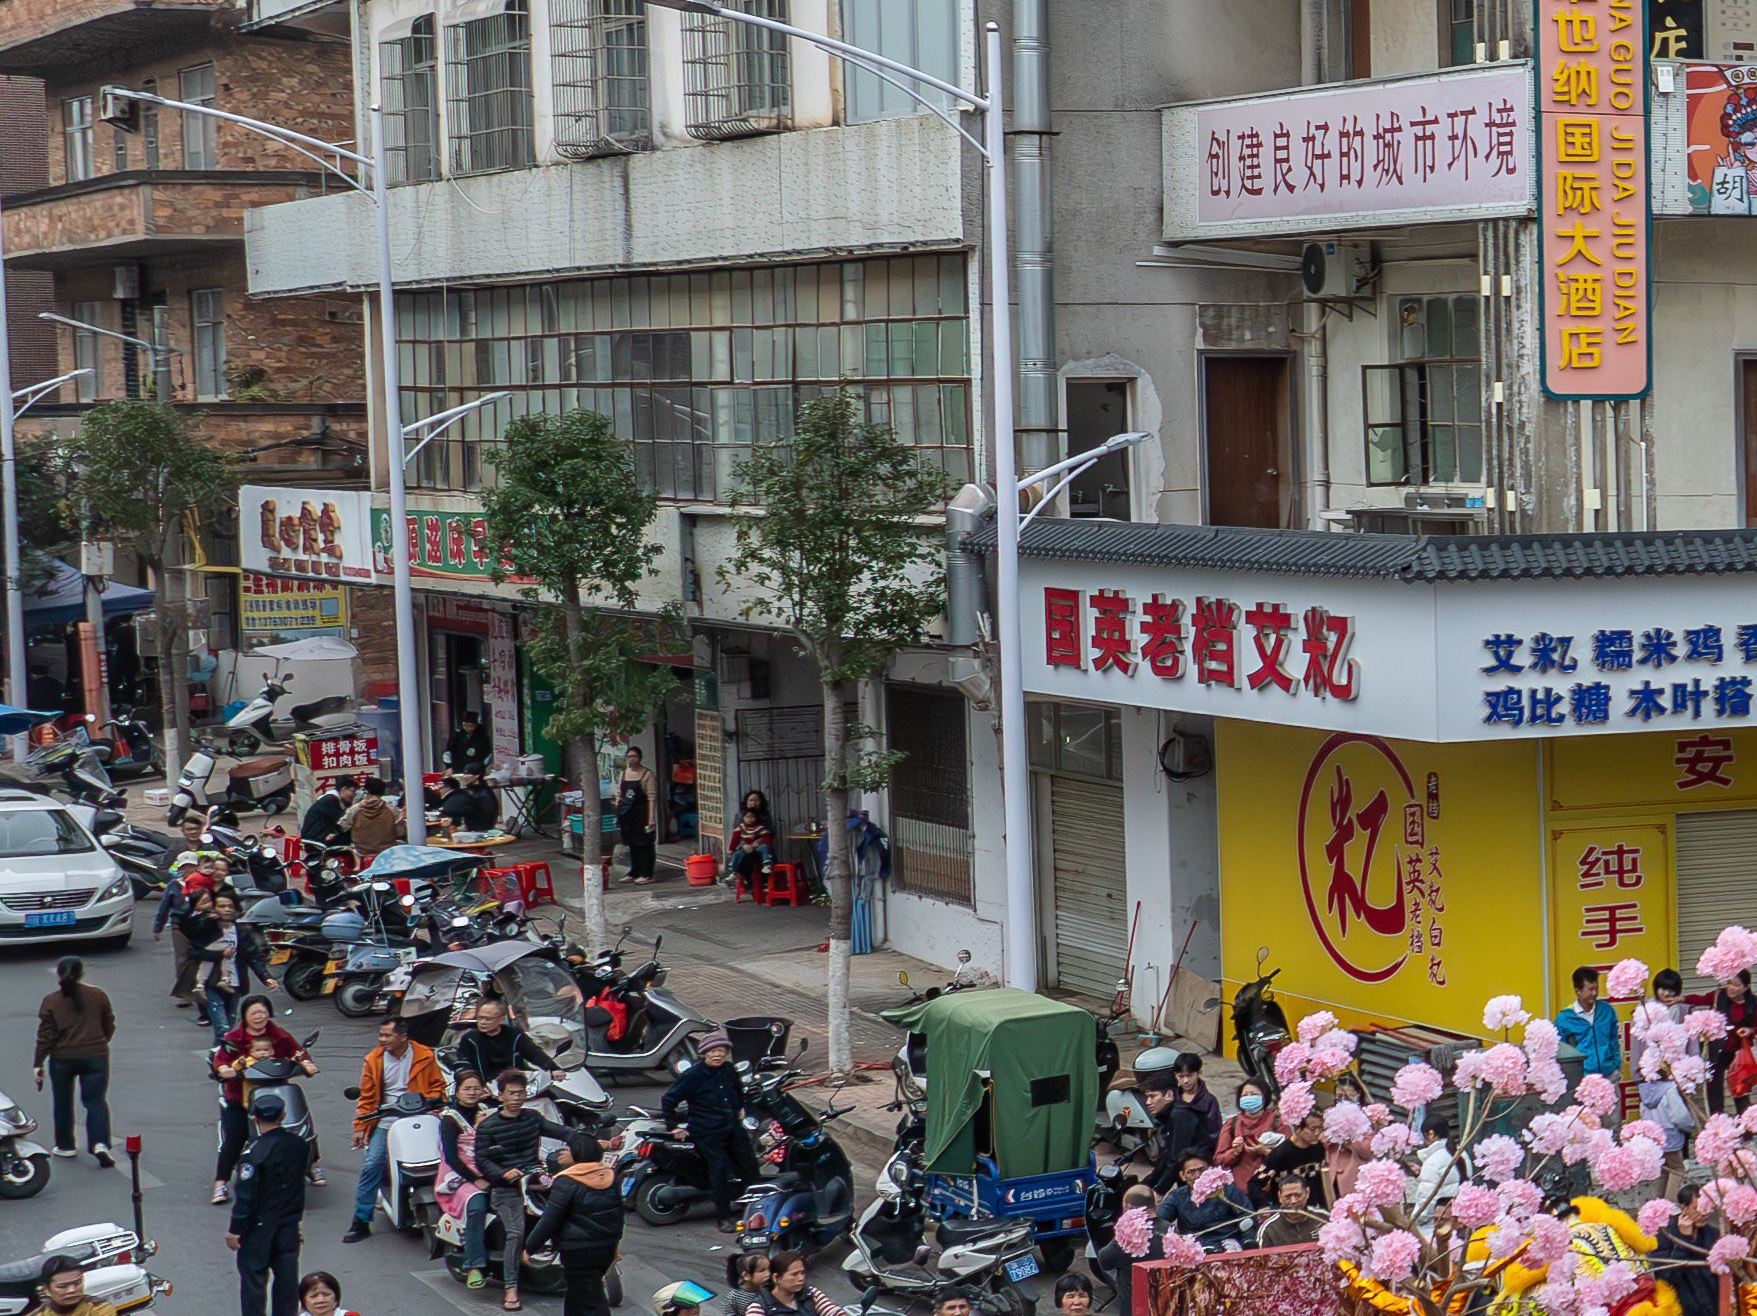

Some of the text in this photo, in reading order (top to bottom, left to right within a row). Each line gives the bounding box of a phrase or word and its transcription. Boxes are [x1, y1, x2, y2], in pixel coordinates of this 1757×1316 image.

[1206, 97, 1518, 201] 创建良好的城市环境
[1715, 172, 1745, 204] 胡
[1593, 624, 1725, 672] 糯米鸡
[321, 739, 368, 756] 排骨饭
[321, 753, 369, 769] 扣肉饭
